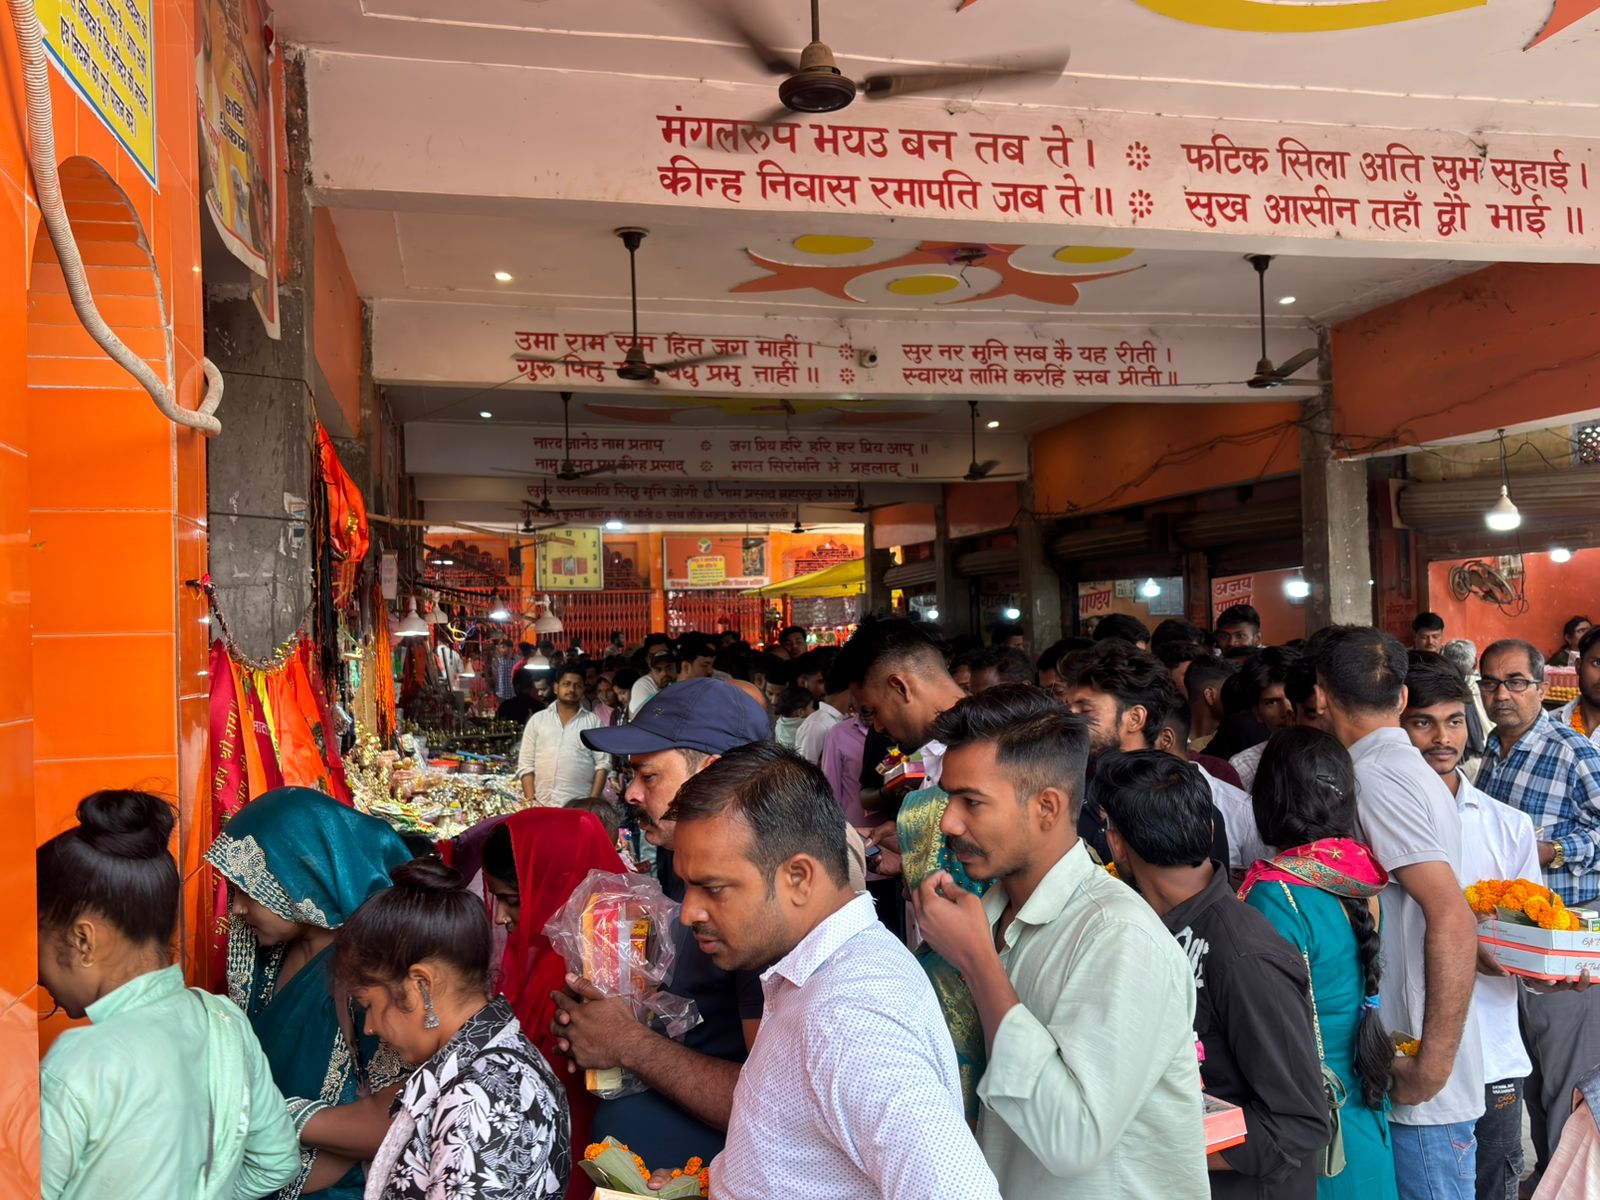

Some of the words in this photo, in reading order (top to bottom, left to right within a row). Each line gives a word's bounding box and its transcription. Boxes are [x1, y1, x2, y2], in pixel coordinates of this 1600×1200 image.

[657, 105, 802, 154] मंगलरूप
[810, 124, 889, 159] भयउ
[899, 128, 957, 161] बन
[969, 132, 1029, 165] तब
[1040, 125, 1074, 168] ते
[1180, 133, 1269, 176] फटिक
[1276, 136, 1351, 181] सिला
[1359, 142, 1425, 184] अति
[1490, 149, 1570, 196] सुहाई
[657, 154, 745, 203] कीन्ह
[756, 160, 860, 206] निवास
[868, 169, 982, 210] रमापति
[992, 182, 1048, 214] जब
[1055, 173, 1085, 218] ते
[1184, 191, 1251, 228] सुख
[1264, 184, 1361, 228] आसीन
[1368, 189, 1423, 232] तहाँ
[1486, 192, 1552, 239] भाई
[514, 331, 559, 352] उमा
[564, 333, 606, 353] राम
[664, 332, 705, 358] हित
[711, 337, 750, 357] जग
[755, 333, 800, 361] माहीं
[902, 343, 933, 364] सुर
[938, 344, 965, 362] नर
[969, 338, 1009, 365] मुनि
[1013, 345, 1048, 363] सब
[1054, 339, 1075, 363] कै
[1077, 346, 1107, 364] यह
[1115, 340, 1158, 365] रीती
[706, 364, 744, 388] प्रभु
[751, 359, 801, 388] नाहीं
[902, 367, 963, 386] स्वारथ
[1013, 363, 1066, 388] करहिं
[1073, 369, 1111, 387] सब
[1118, 364, 1163, 387] प्रीती
[533, 437, 563, 451] नारद
[601, 438, 625, 451] नाम
[730, 439, 751, 452] जग
[561, 458, 594, 472] पत
[215, 765, 228, 792] जय
[225, 709, 240, 740] राम
